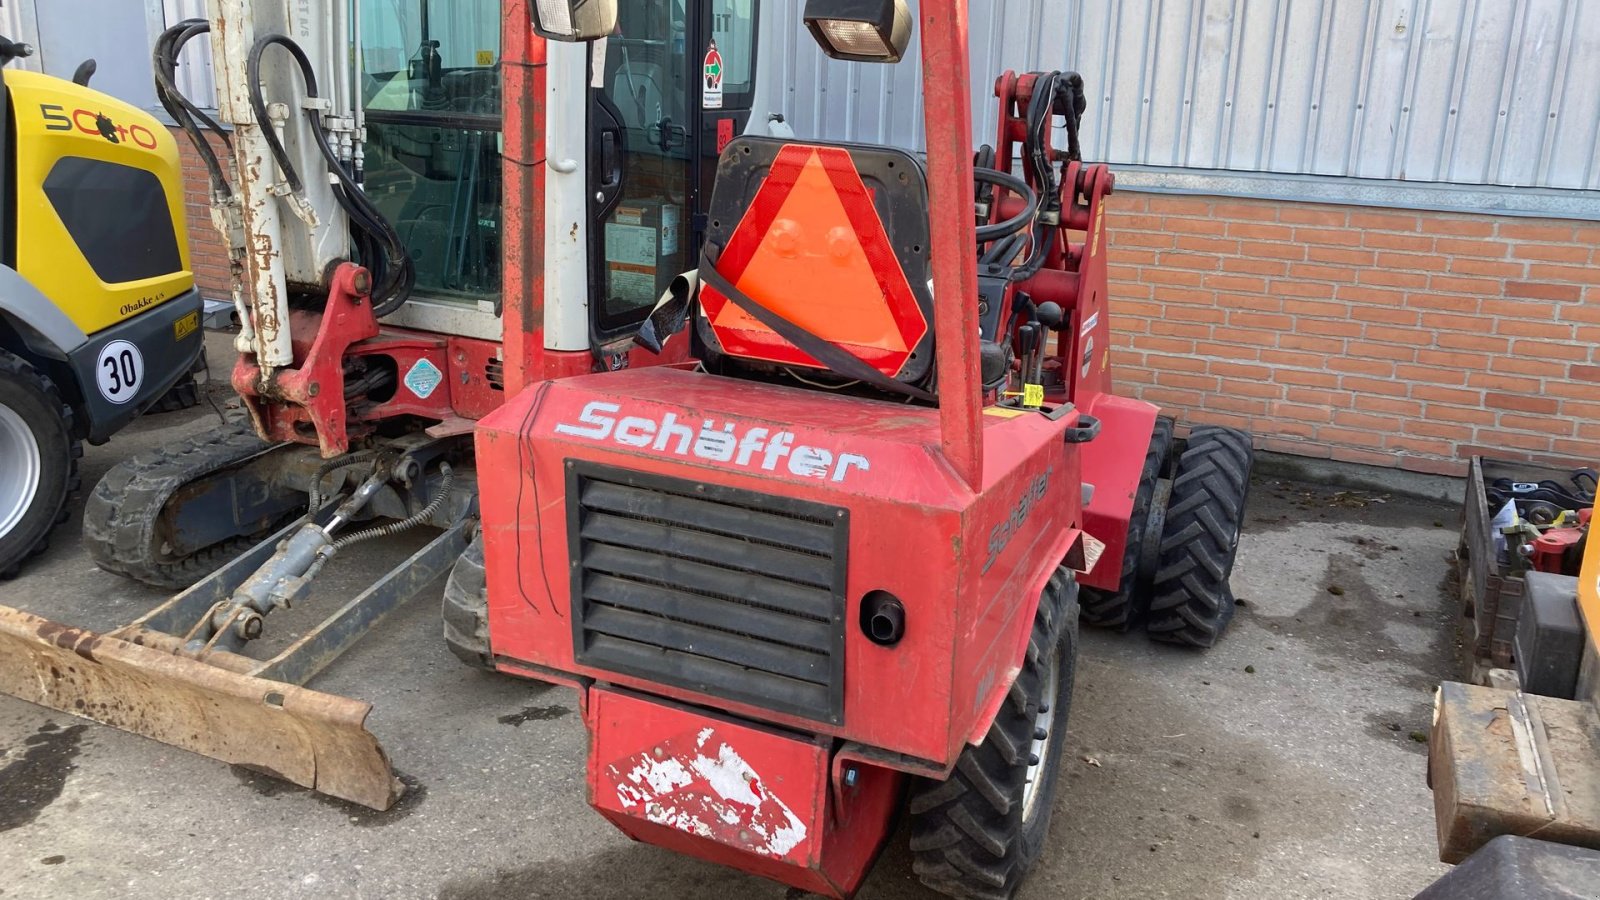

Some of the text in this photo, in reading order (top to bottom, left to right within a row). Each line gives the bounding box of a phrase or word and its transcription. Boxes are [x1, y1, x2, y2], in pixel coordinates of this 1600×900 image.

[119, 296, 154, 316] Obakke
[103, 349, 137, 395] 30
[553, 400, 871, 482] Schäffer
